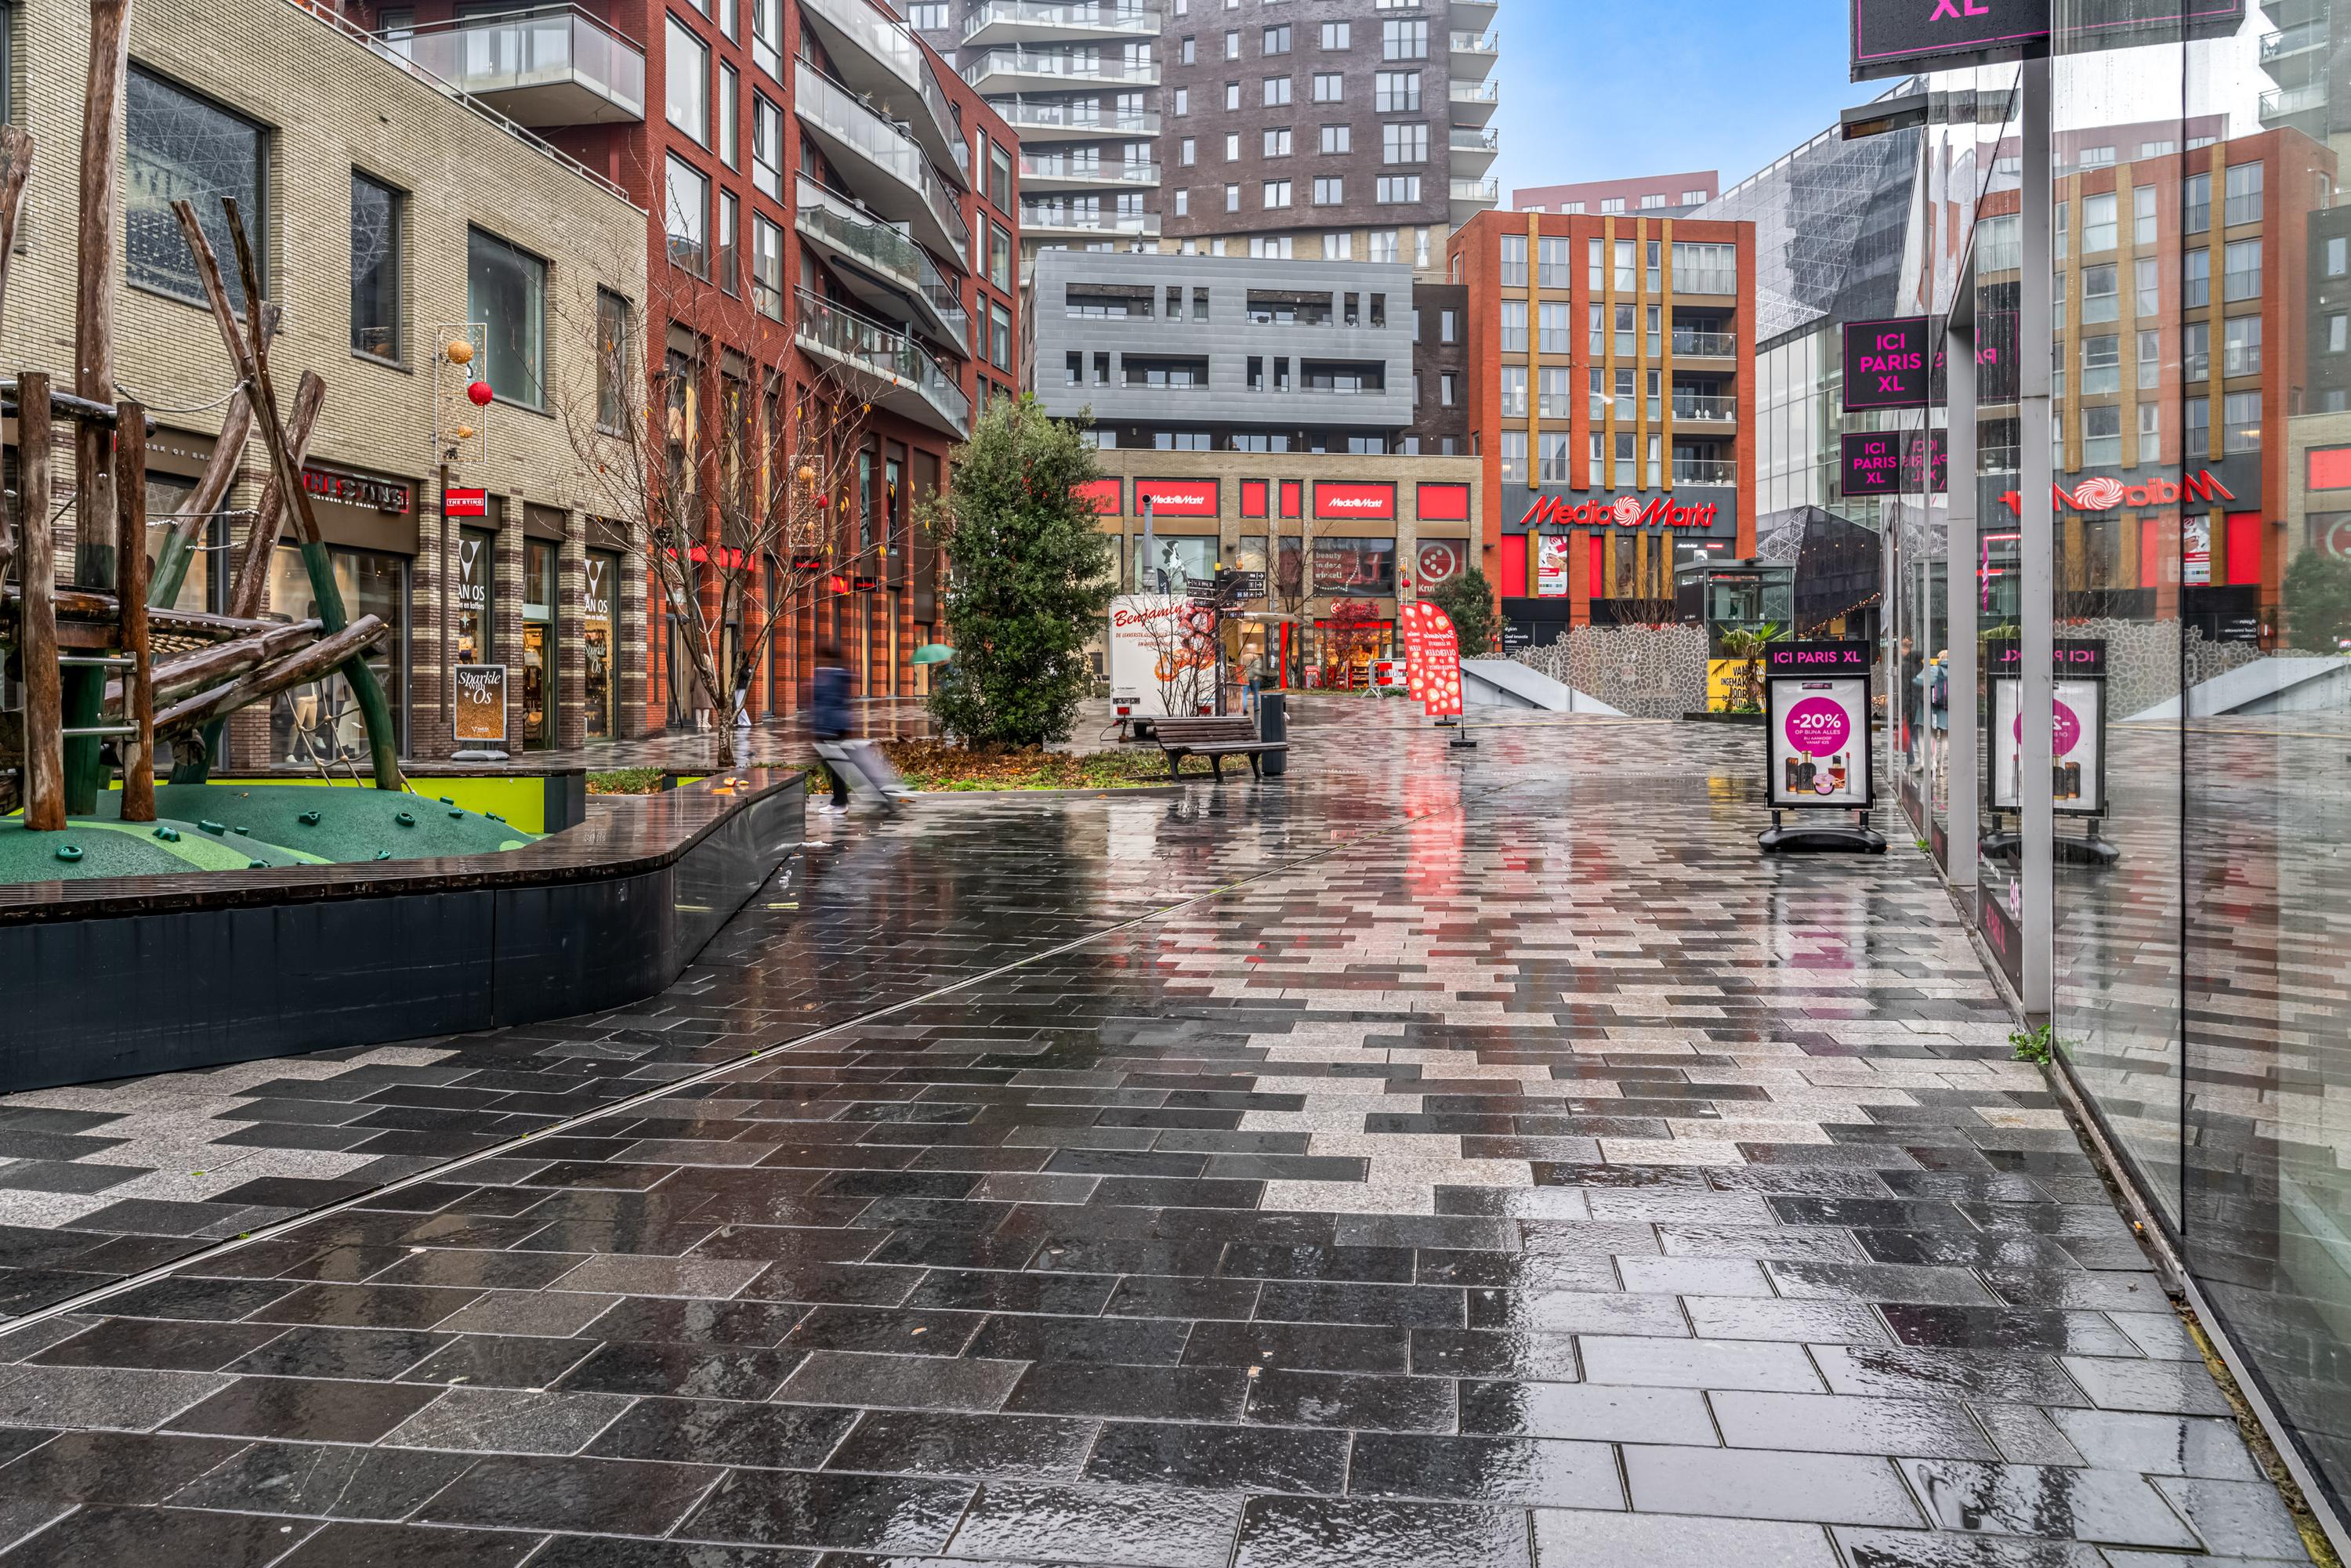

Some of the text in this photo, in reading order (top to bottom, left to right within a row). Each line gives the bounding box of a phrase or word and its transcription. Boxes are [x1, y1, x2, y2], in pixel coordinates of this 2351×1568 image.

[1877, 333, 1905, 351] ICI
[1860, 353, 1922, 372] PARIS
[1878, 375, 1905, 392] XL
[1865, 442, 1886, 454] ICI
[1853, 456, 1896, 469] PARIS
[1867, 472, 1886, 483] XL
[473, 585, 485, 601] OS
[598, 599, 607, 613] OS
[1114, 603, 1183, 628] Benjamin
[1774, 650, 1861, 663] ICI PARIS XL
[458, 671, 501, 686] Sparkle
[473, 688, 492, 704] Os
